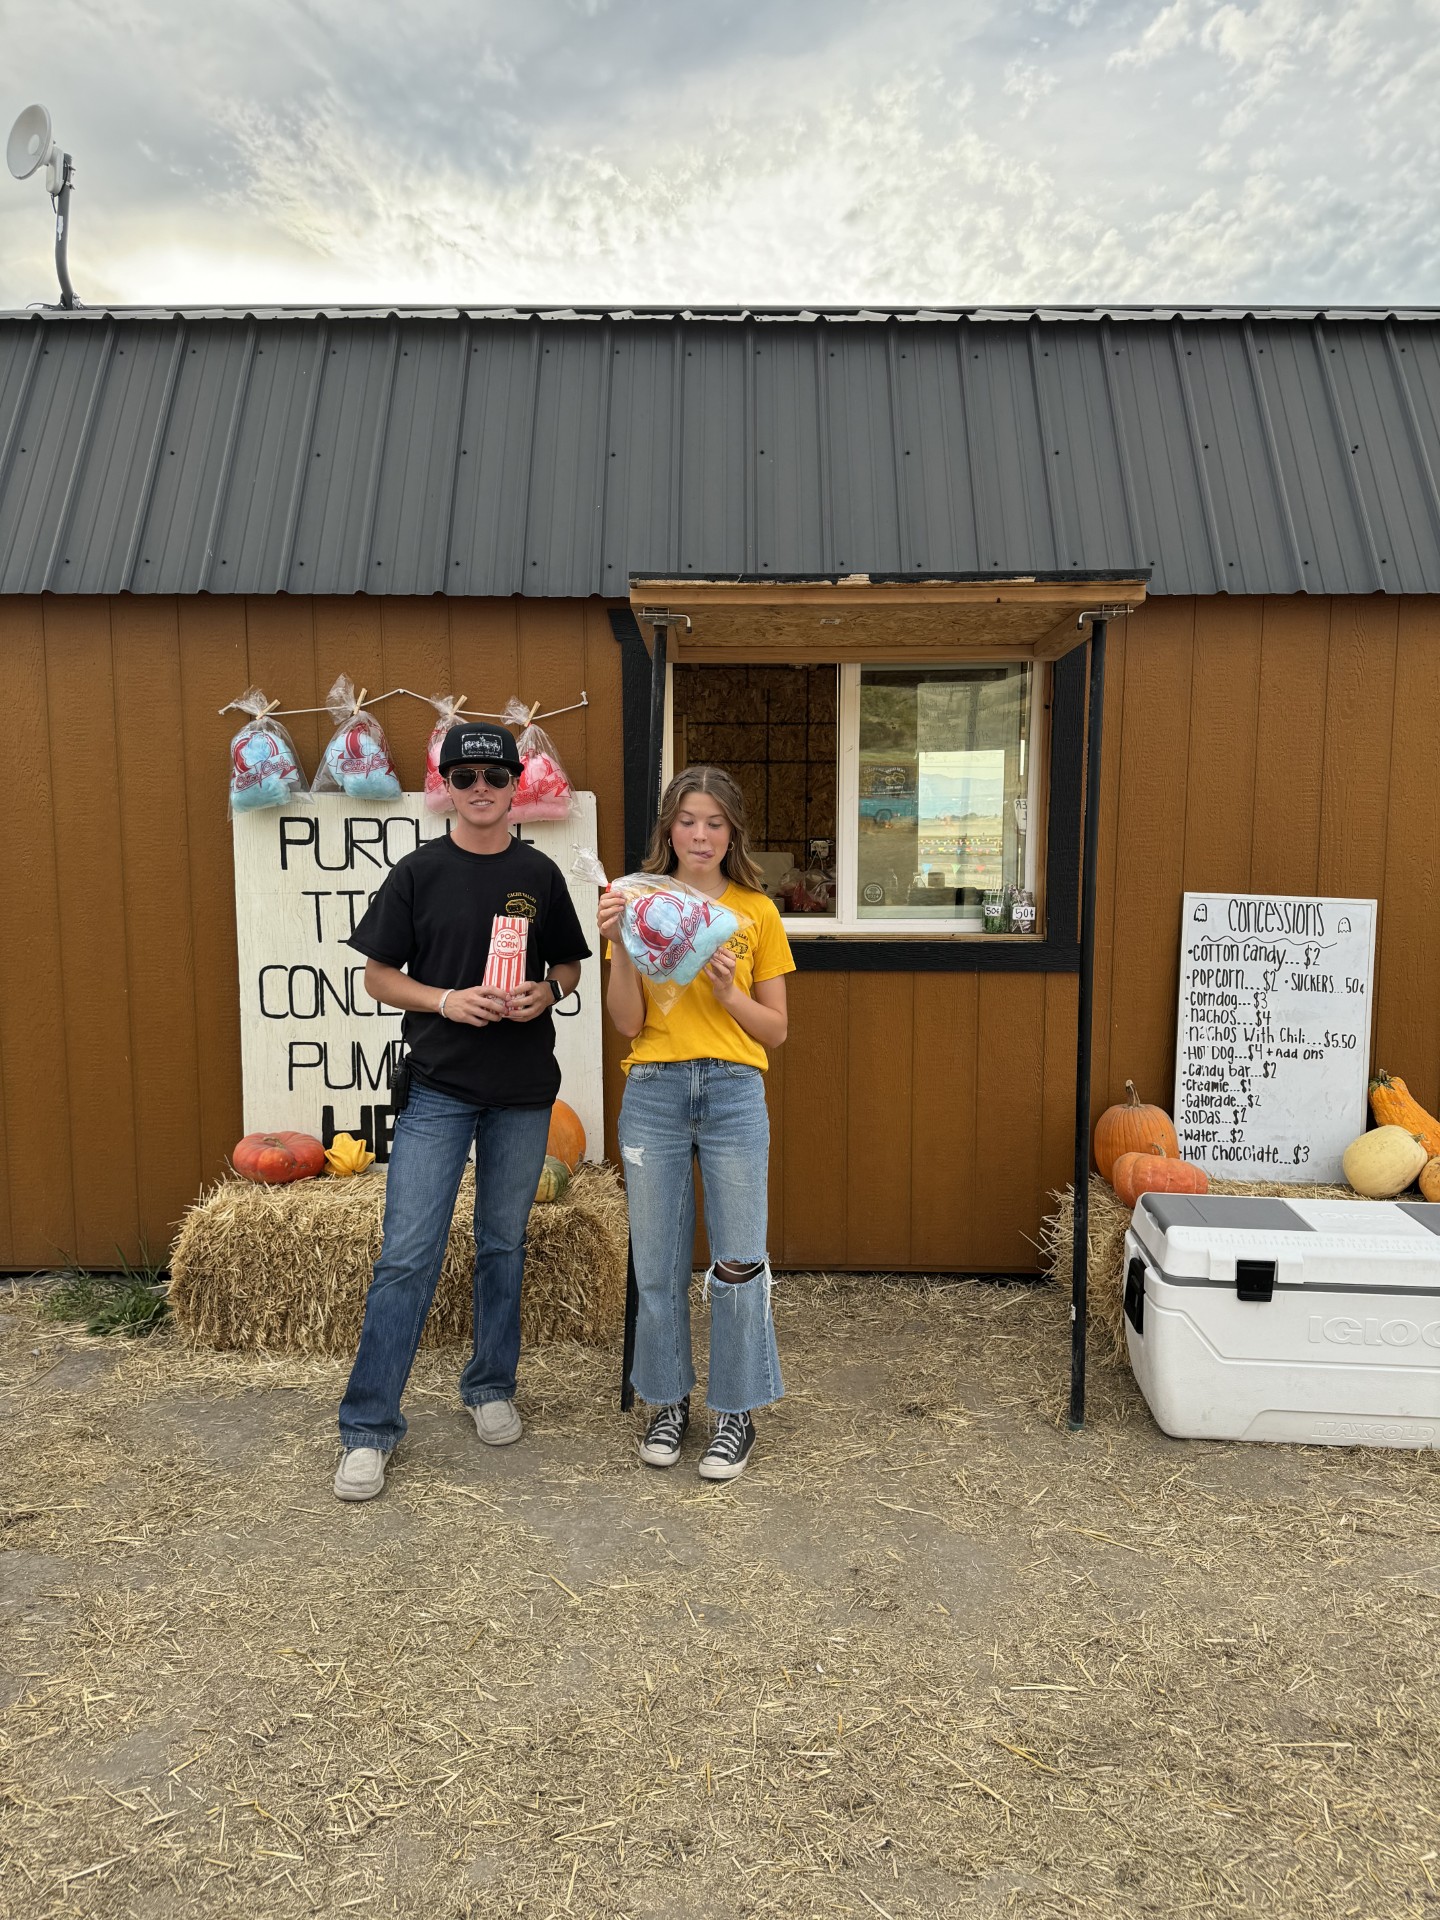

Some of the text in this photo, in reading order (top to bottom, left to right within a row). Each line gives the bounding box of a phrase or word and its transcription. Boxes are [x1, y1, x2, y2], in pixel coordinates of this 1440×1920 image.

[340, 759, 370, 774] Cotton
[985, 906, 1000, 916] 50¢
[1015, 908, 1034, 920] 50¢
[496, 940, 519, 949] CORN
[500, 933, 517, 941] POP
[1303, 944, 1321, 970] $2
[1263, 969, 1279, 993] $2
[1253, 991, 1268, 1010] $3
[1255, 1010, 1272, 1027] $4
[1243, 1027, 1275, 1044] With
[1323, 1030, 1357, 1049] $5.50
[1248, 1044, 1263, 1061] $4
[1275, 1048, 1298, 1059] Add
[1303, 1048, 1324, 1060] ons
[1262, 1061, 1277, 1079] $2
[1247, 1093, 1262, 1109] $2
[1232, 1107, 1248, 1125] $2
[1229, 1127, 1245, 1143] $2
[1183, 1145, 1208, 1161] HOT
[1292, 1143, 1310, 1165] $3
[1311, 1420, 1436, 1443] MAXCOLD
